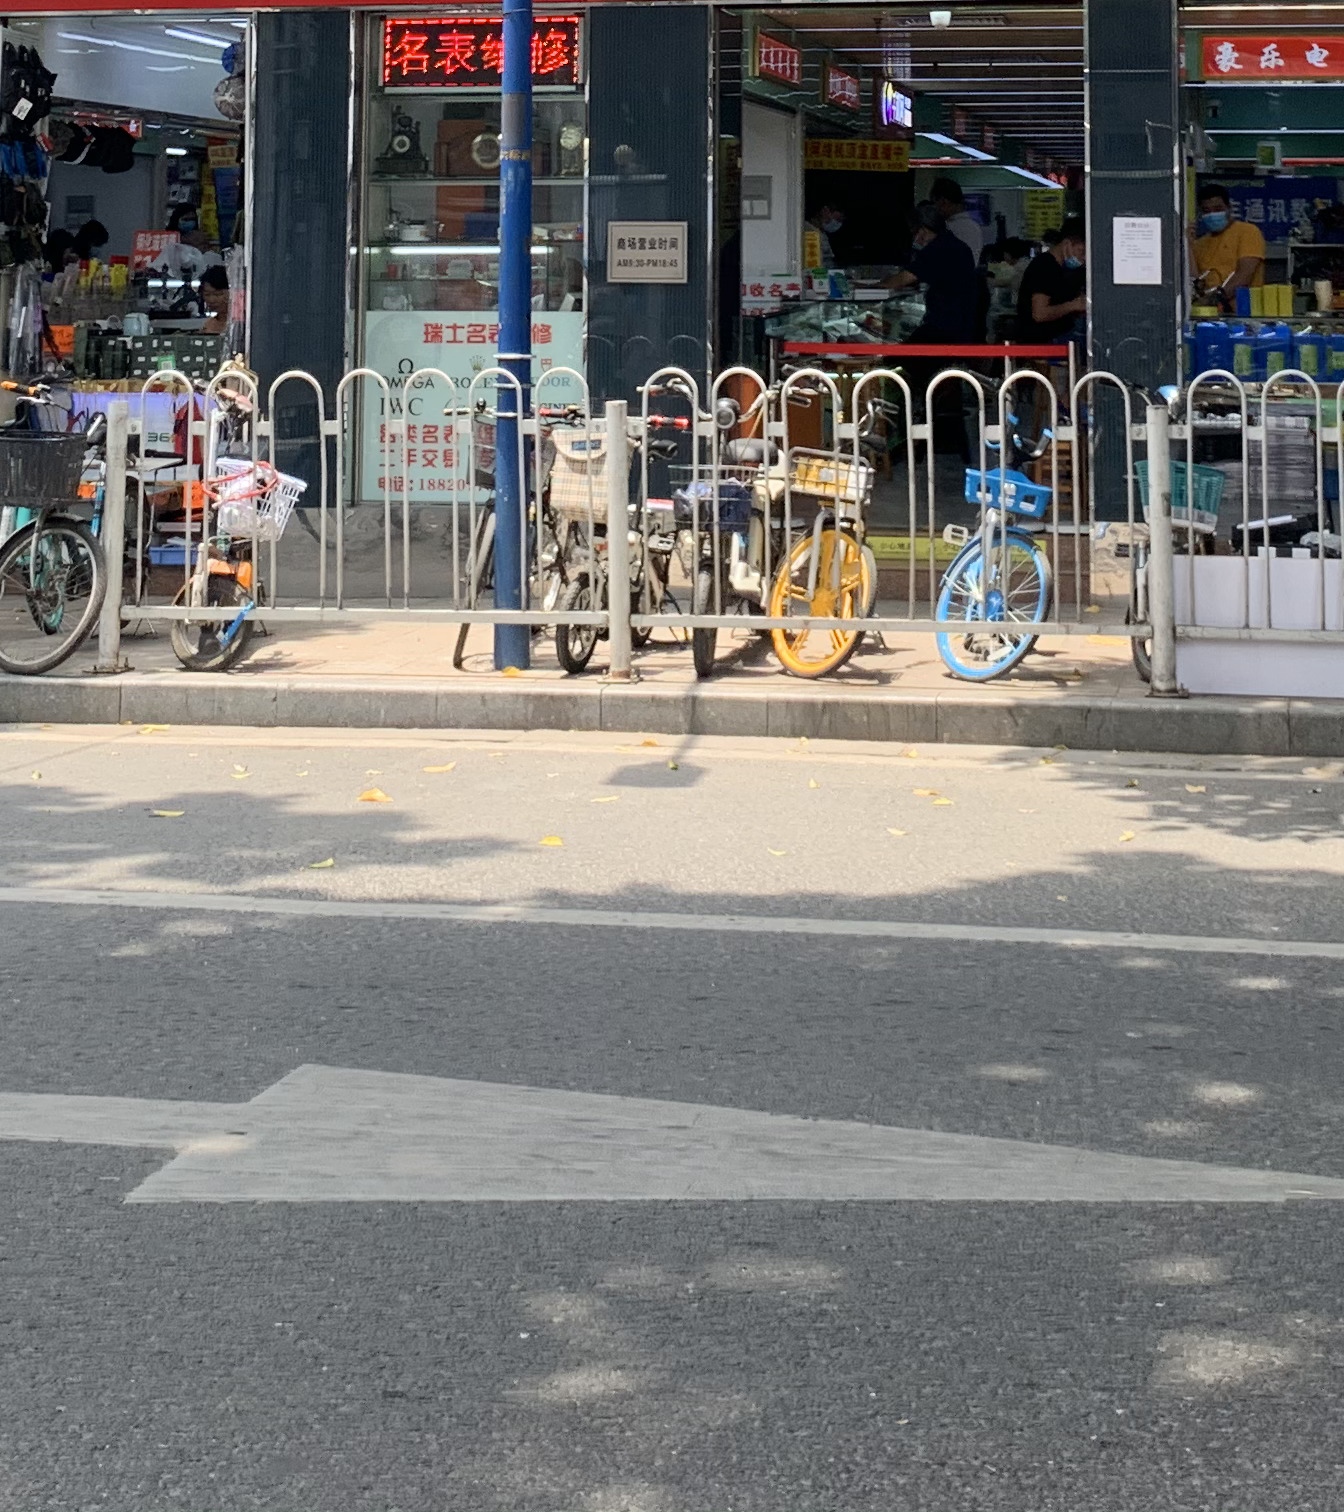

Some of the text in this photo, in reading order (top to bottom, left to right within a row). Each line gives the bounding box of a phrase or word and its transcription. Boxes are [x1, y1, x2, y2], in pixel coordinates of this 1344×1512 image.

[617, 237, 678, 251] 商场营业时间
[423, 323, 552, 345] 瑞士名表修
[380, 397, 423, 416] IWC
